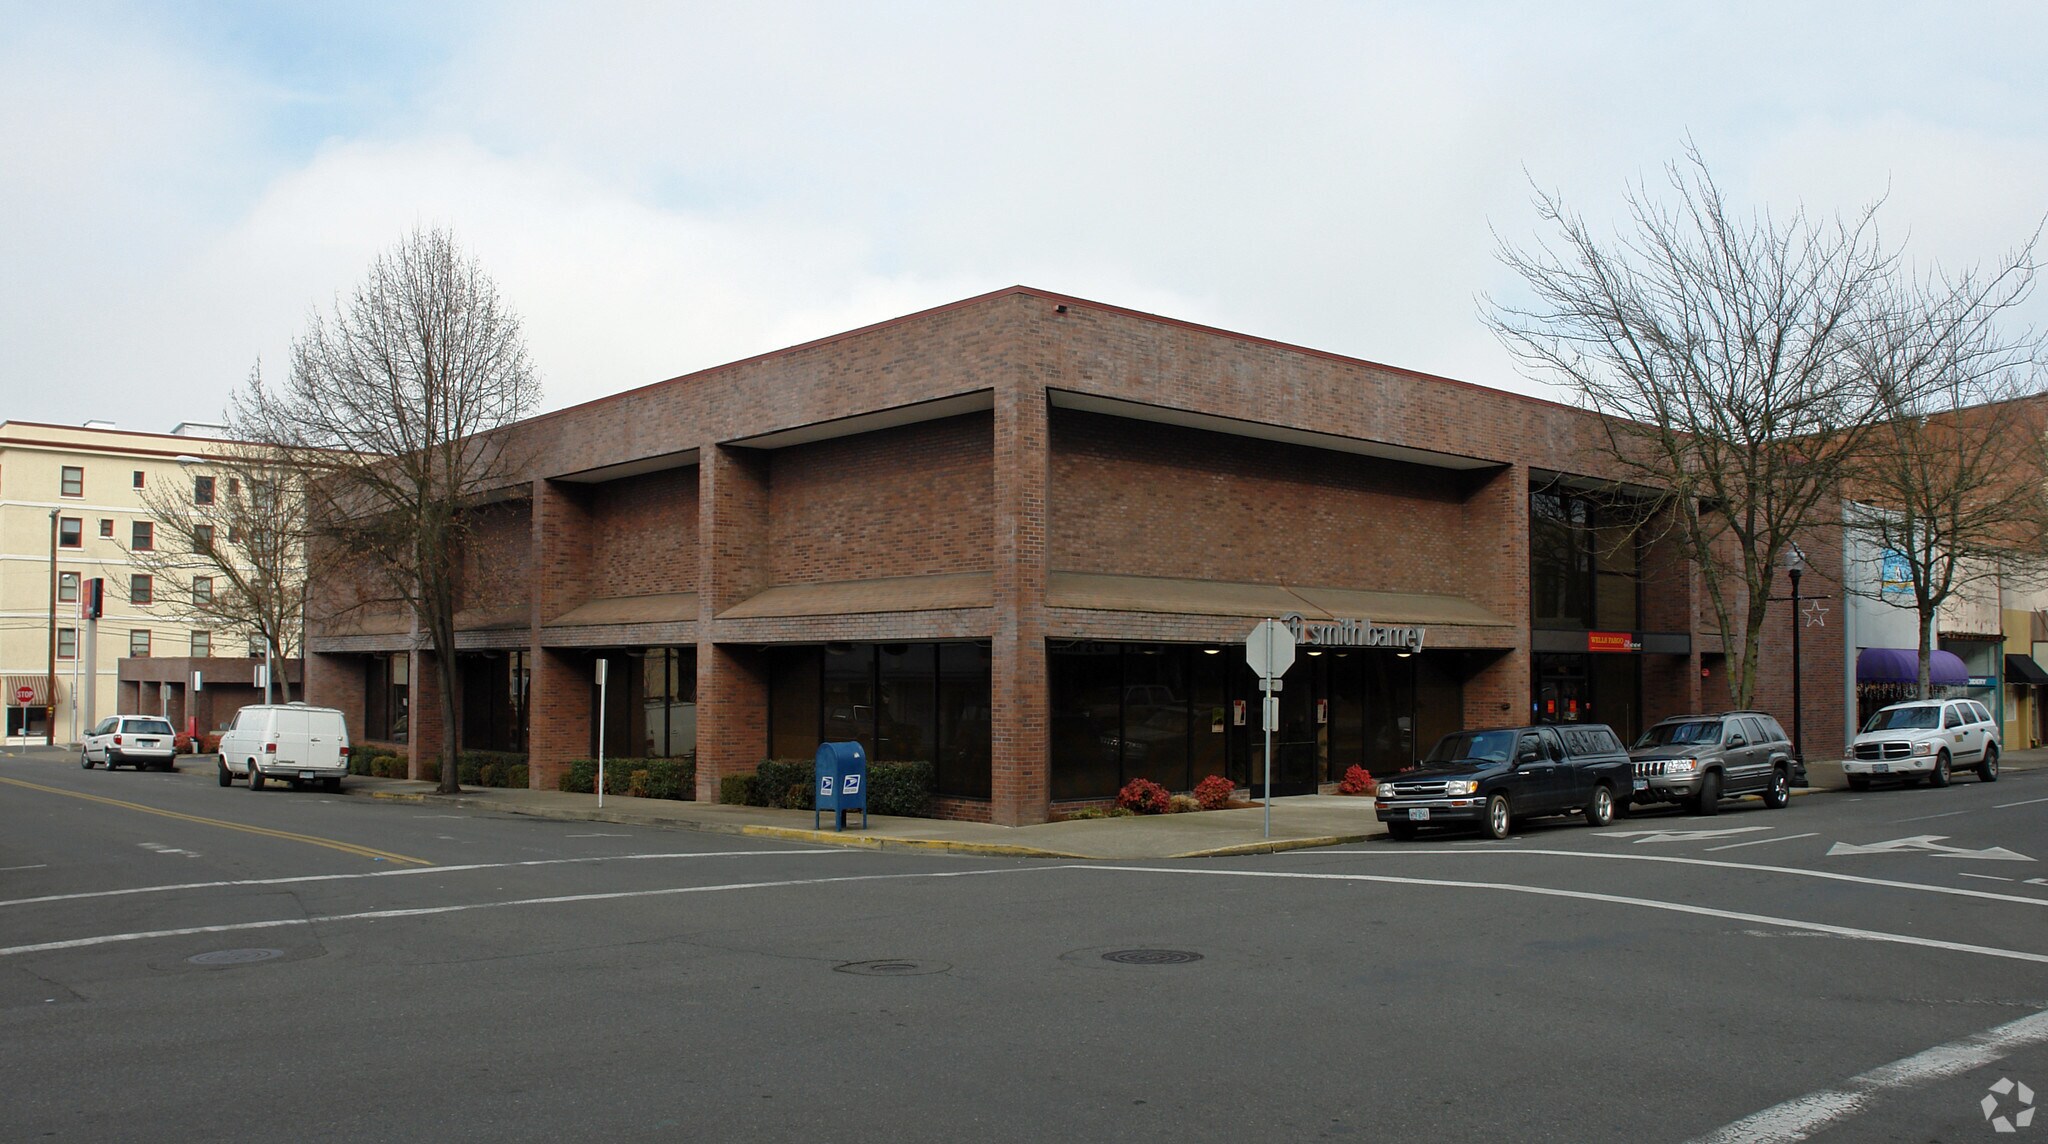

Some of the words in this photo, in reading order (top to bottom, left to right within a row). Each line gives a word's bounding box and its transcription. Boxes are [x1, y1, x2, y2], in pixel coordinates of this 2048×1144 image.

[1309, 618, 1362, 645] smith
[1361, 618, 1425, 653] barney
[17, 690, 34, 698] STOP
